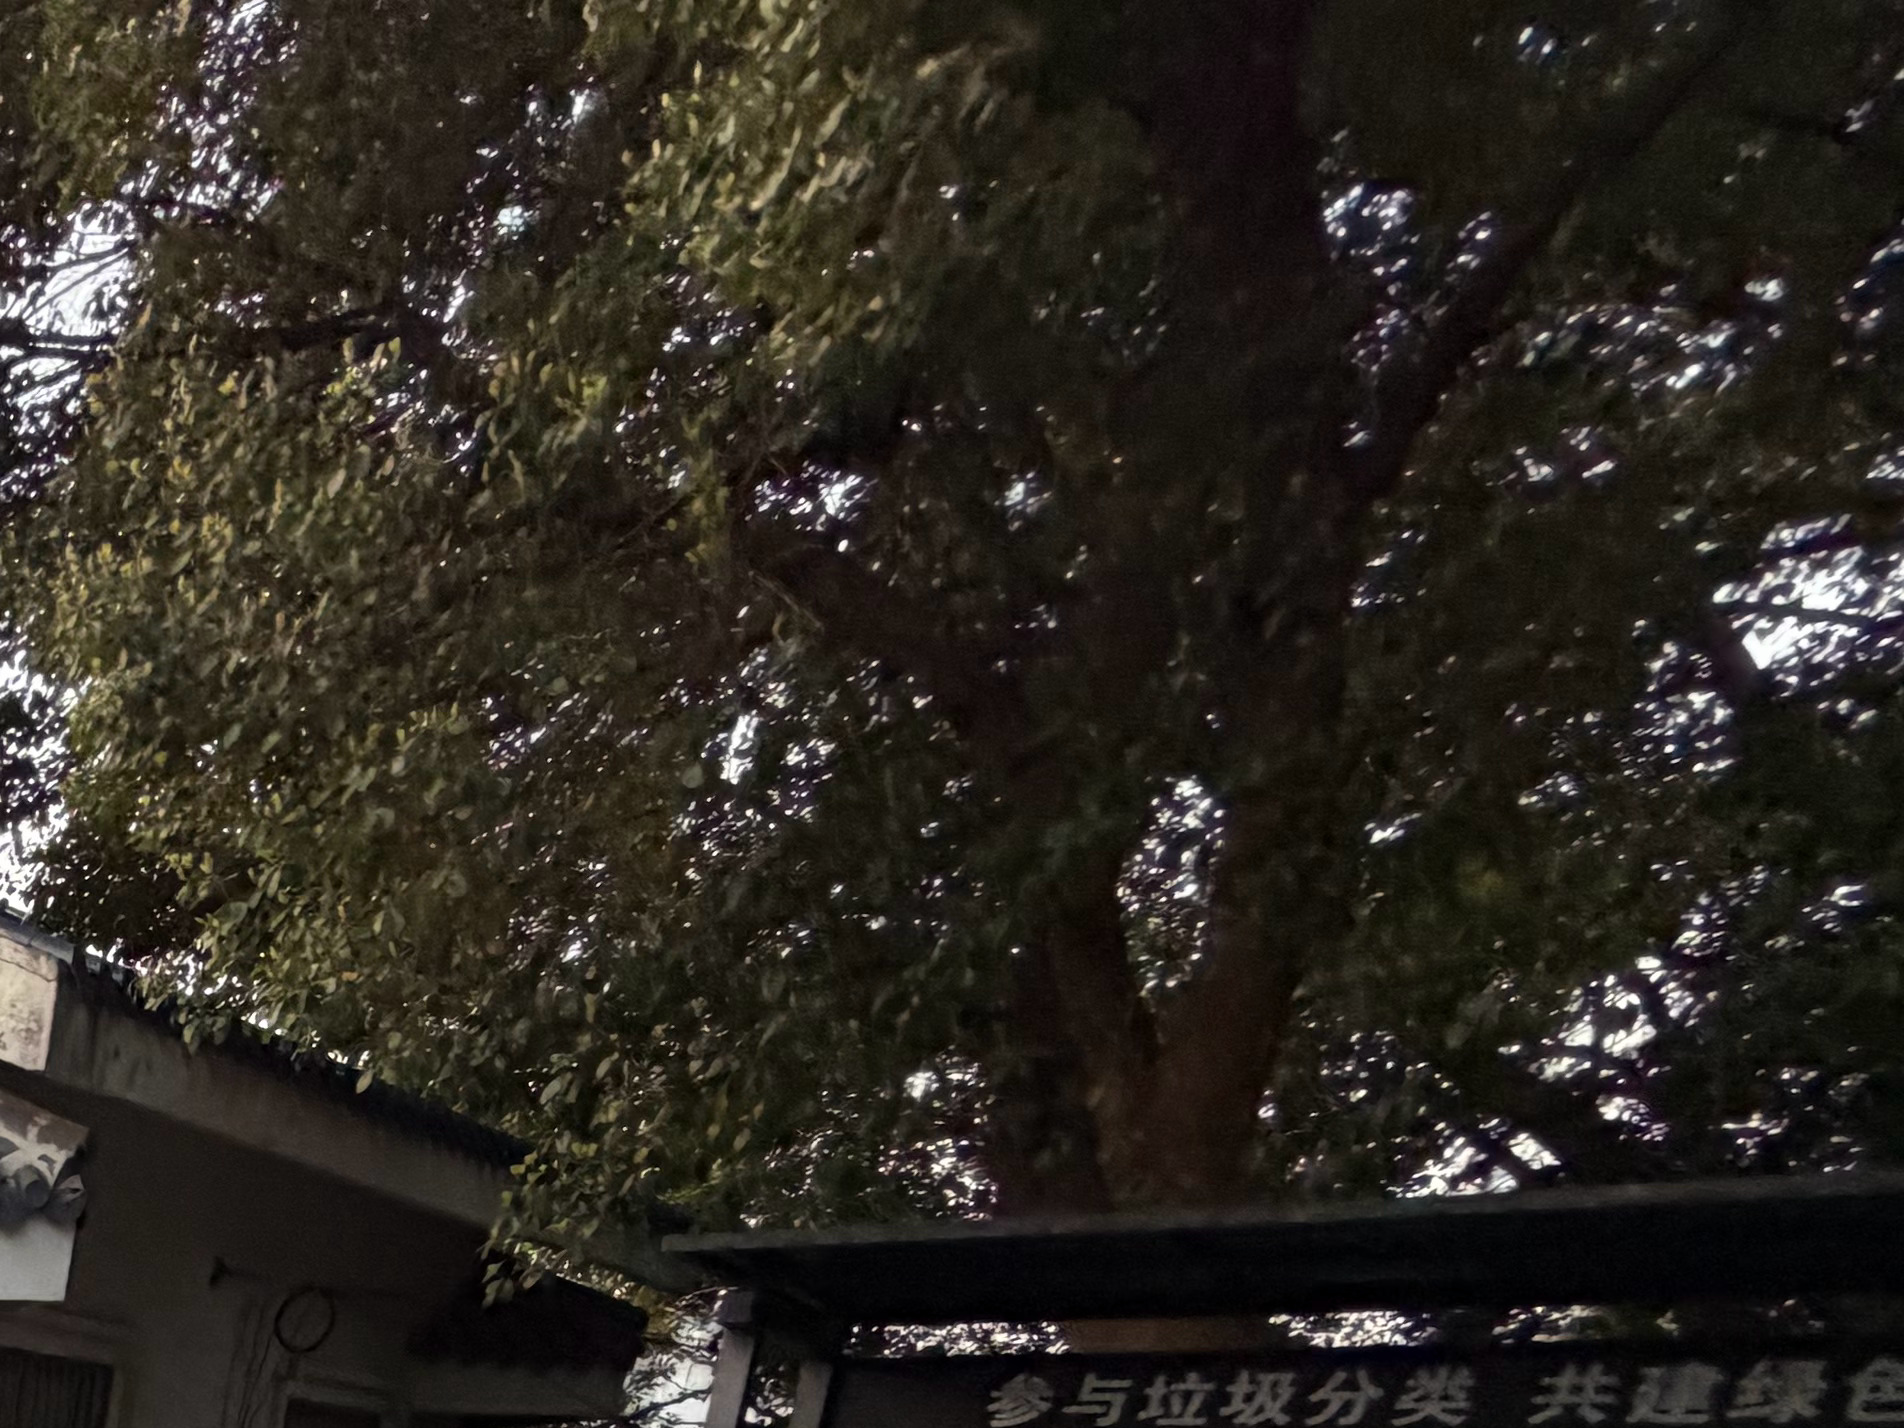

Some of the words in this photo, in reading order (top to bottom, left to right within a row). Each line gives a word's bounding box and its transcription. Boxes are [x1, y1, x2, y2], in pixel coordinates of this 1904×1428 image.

[988, 1367, 1477, 1428] 参与垃圾分类
